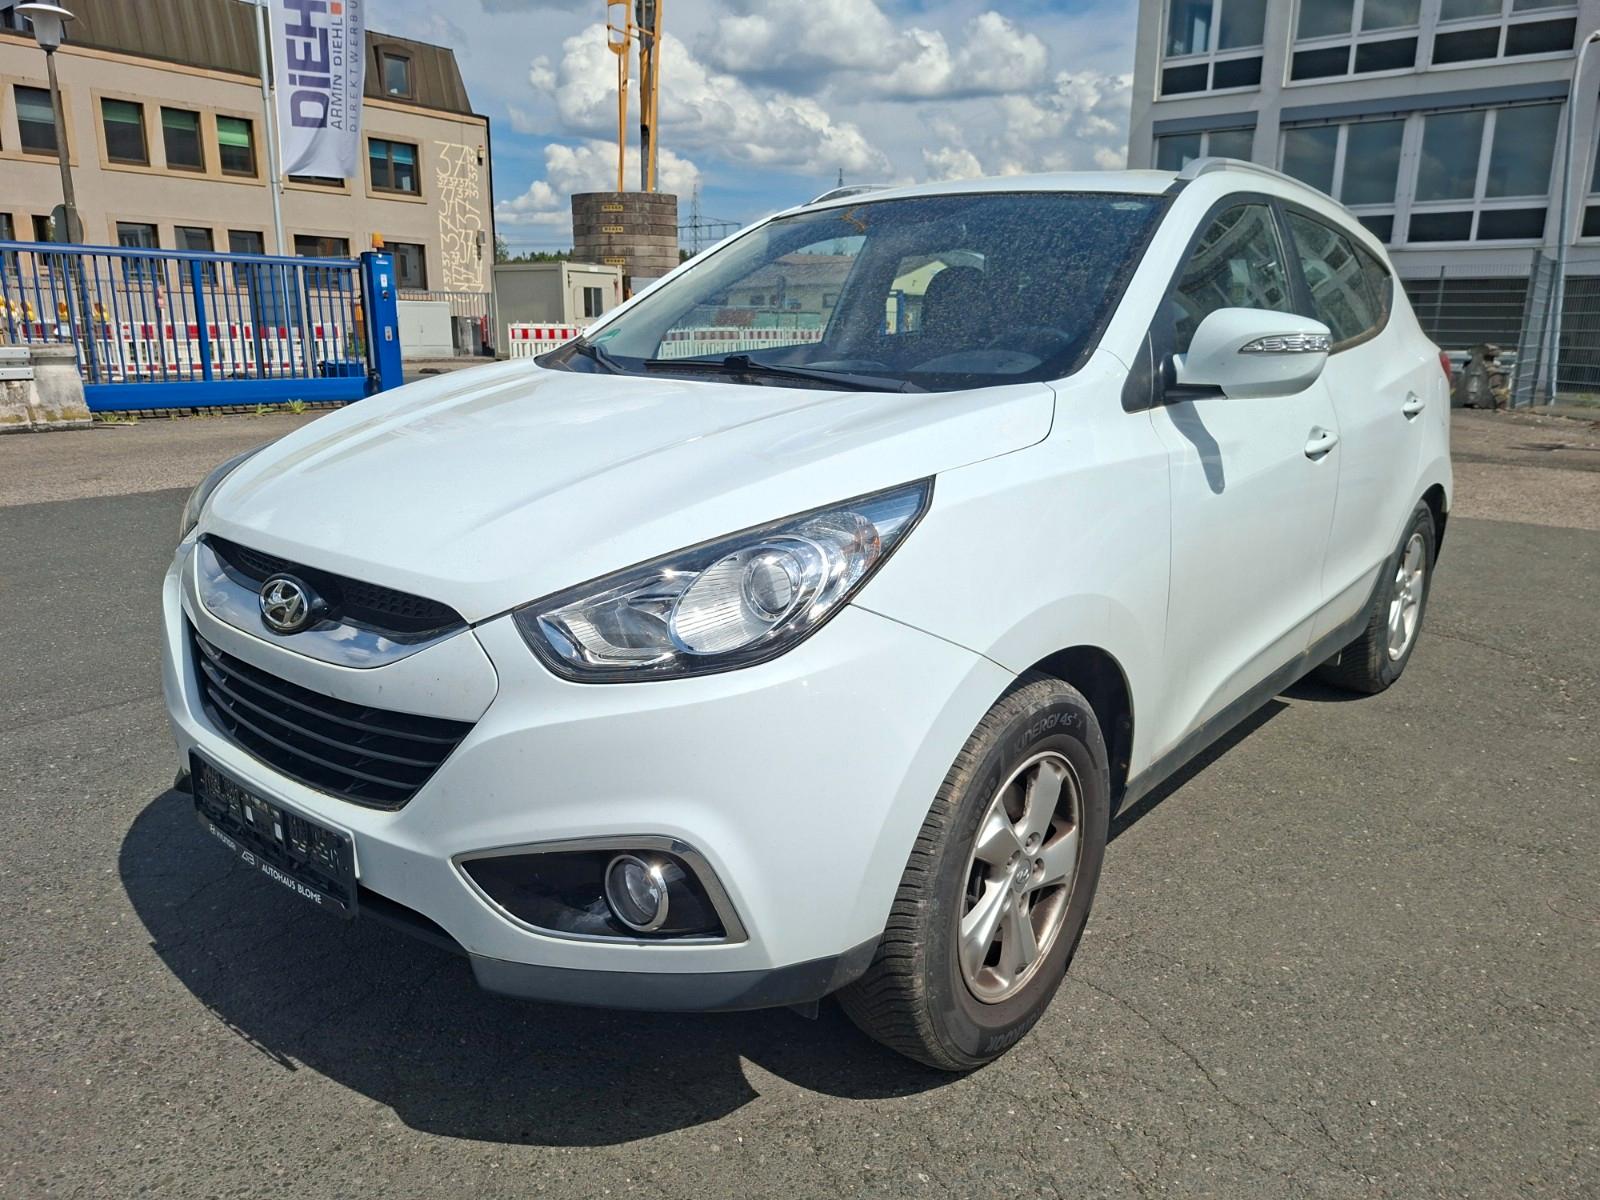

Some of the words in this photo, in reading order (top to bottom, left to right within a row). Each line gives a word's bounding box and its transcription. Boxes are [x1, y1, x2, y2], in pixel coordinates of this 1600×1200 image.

[331, 17, 343, 67] DIEHL
[331, 74, 343, 130] ARMIN
[261, 863, 296, 891] AUTOHAUS
[297, 883, 323, 905] BLOME
